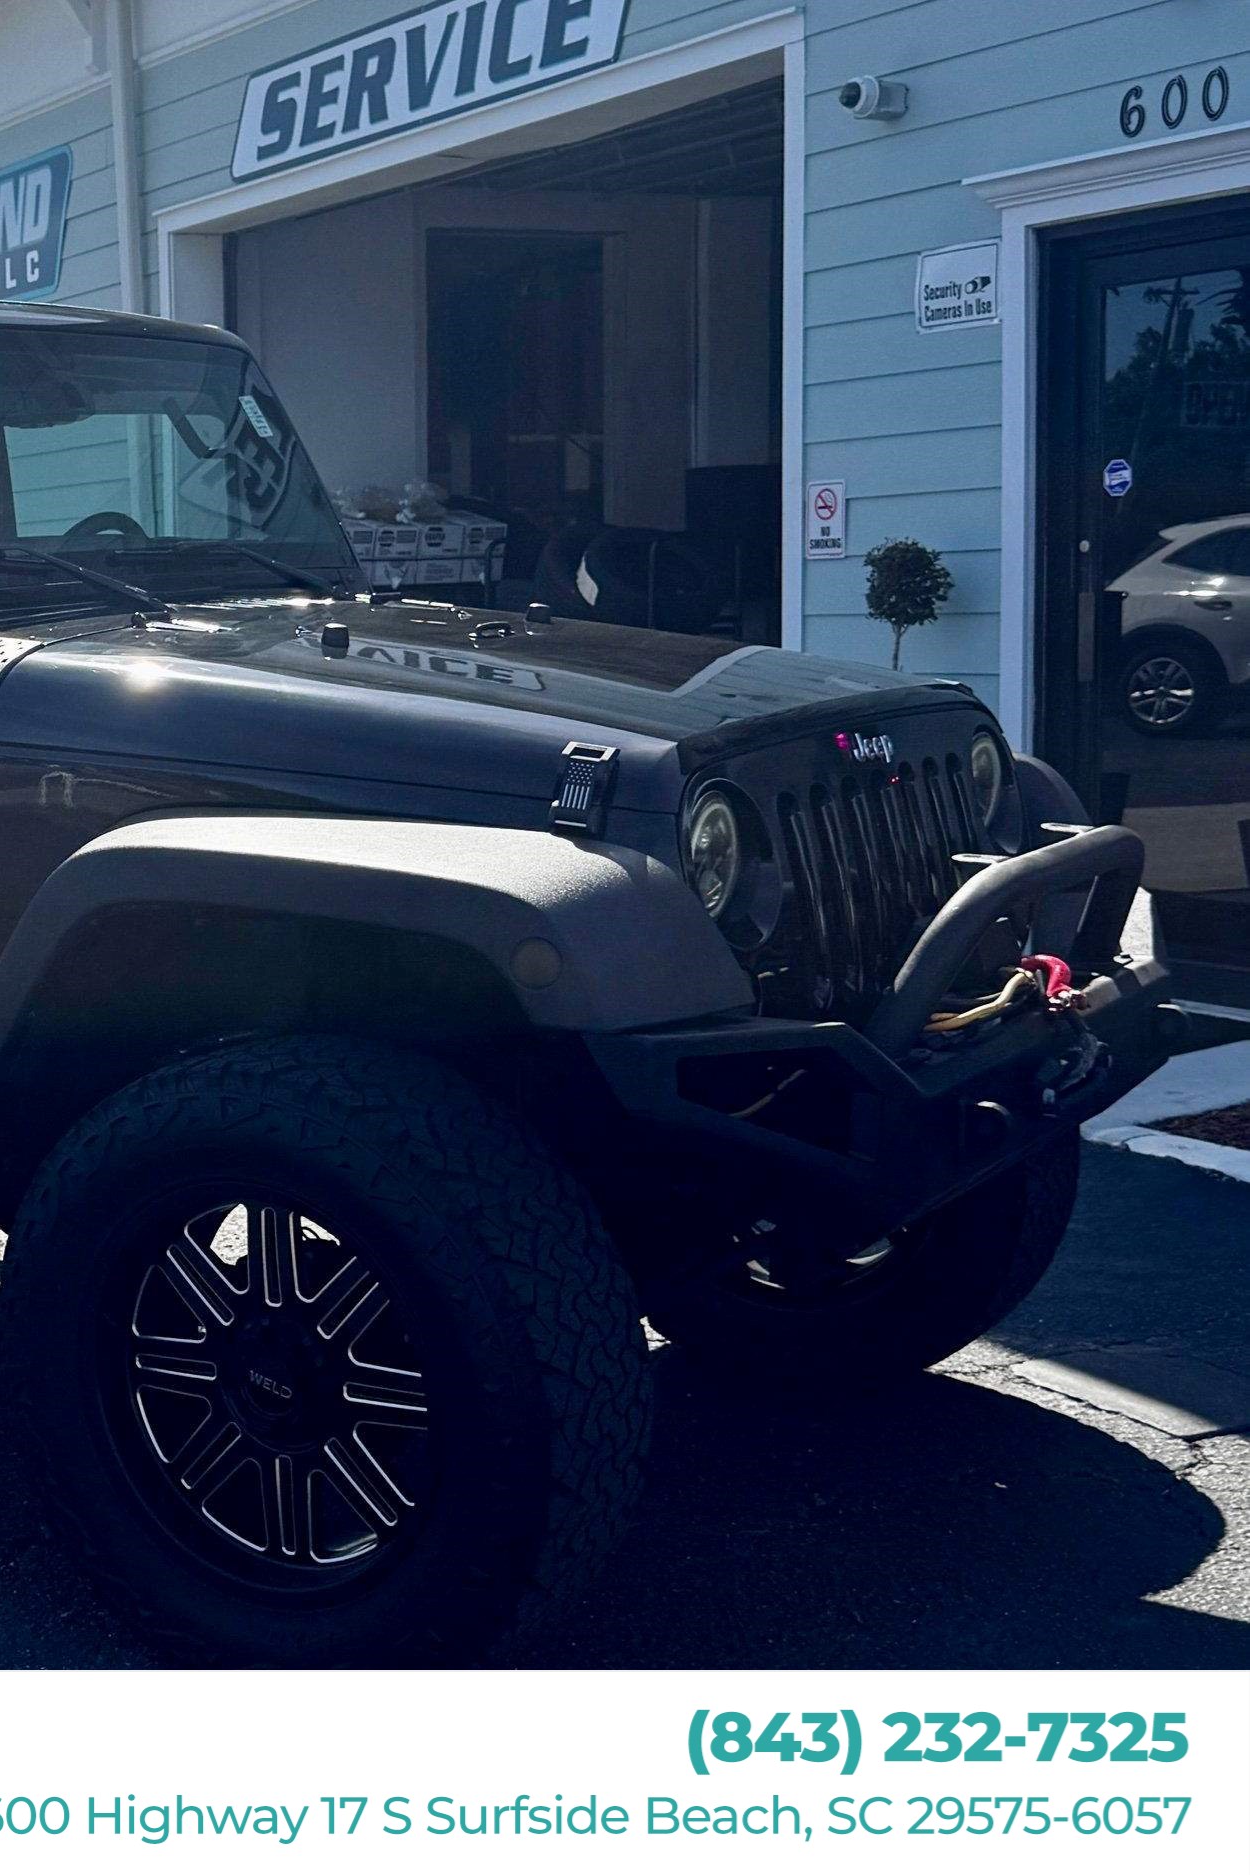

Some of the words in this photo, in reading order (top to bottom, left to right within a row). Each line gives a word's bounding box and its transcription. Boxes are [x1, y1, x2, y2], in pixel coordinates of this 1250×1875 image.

[256, 0, 591, 162] SERVICE
[1119, 66, 1230, 138] 600
[923, 281, 962, 301] Security
[924, 305, 962, 322] Cameras
[964, 300, 973, 317] In
[975, 298, 992, 315] Use
[809, 537, 842, 549] SMOKING
[820, 526, 830, 537] NO
[853, 733, 893, 763] Jeep
[250, 1370, 292, 1398] WELD
